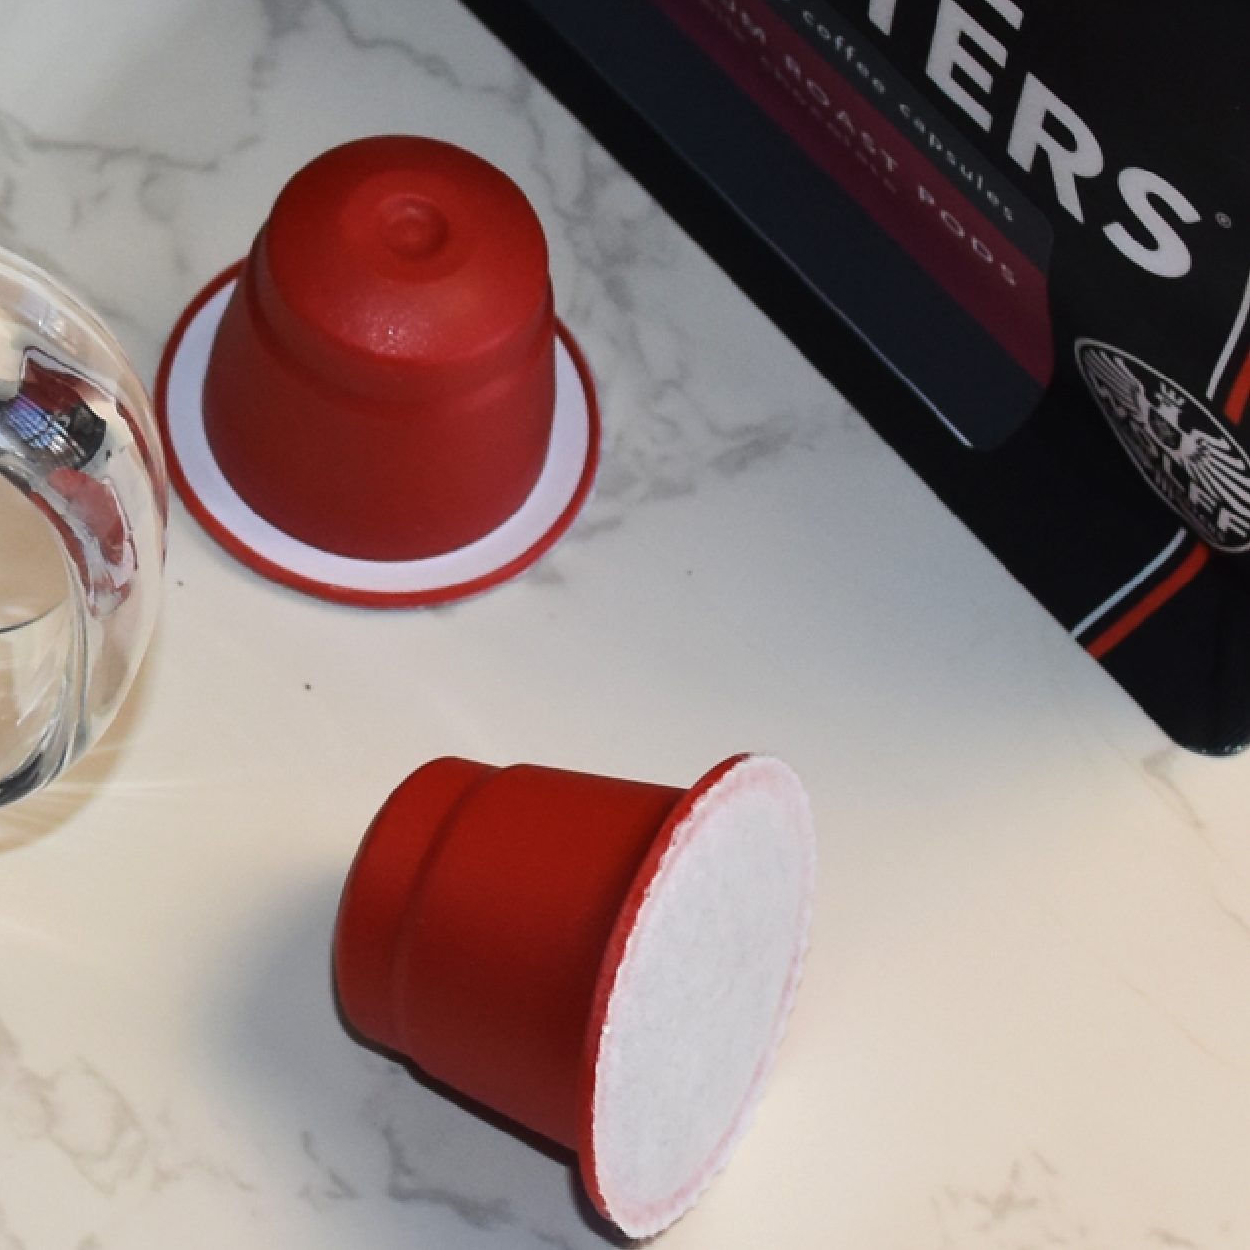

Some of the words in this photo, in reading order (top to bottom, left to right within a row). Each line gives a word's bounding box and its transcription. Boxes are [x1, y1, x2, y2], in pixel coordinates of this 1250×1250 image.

[784, 53, 899, 173] ROAST
[917, 183, 1017, 287] PODS
[802, 10, 886, 95] coffee
[899, 103, 1014, 223] capsules
